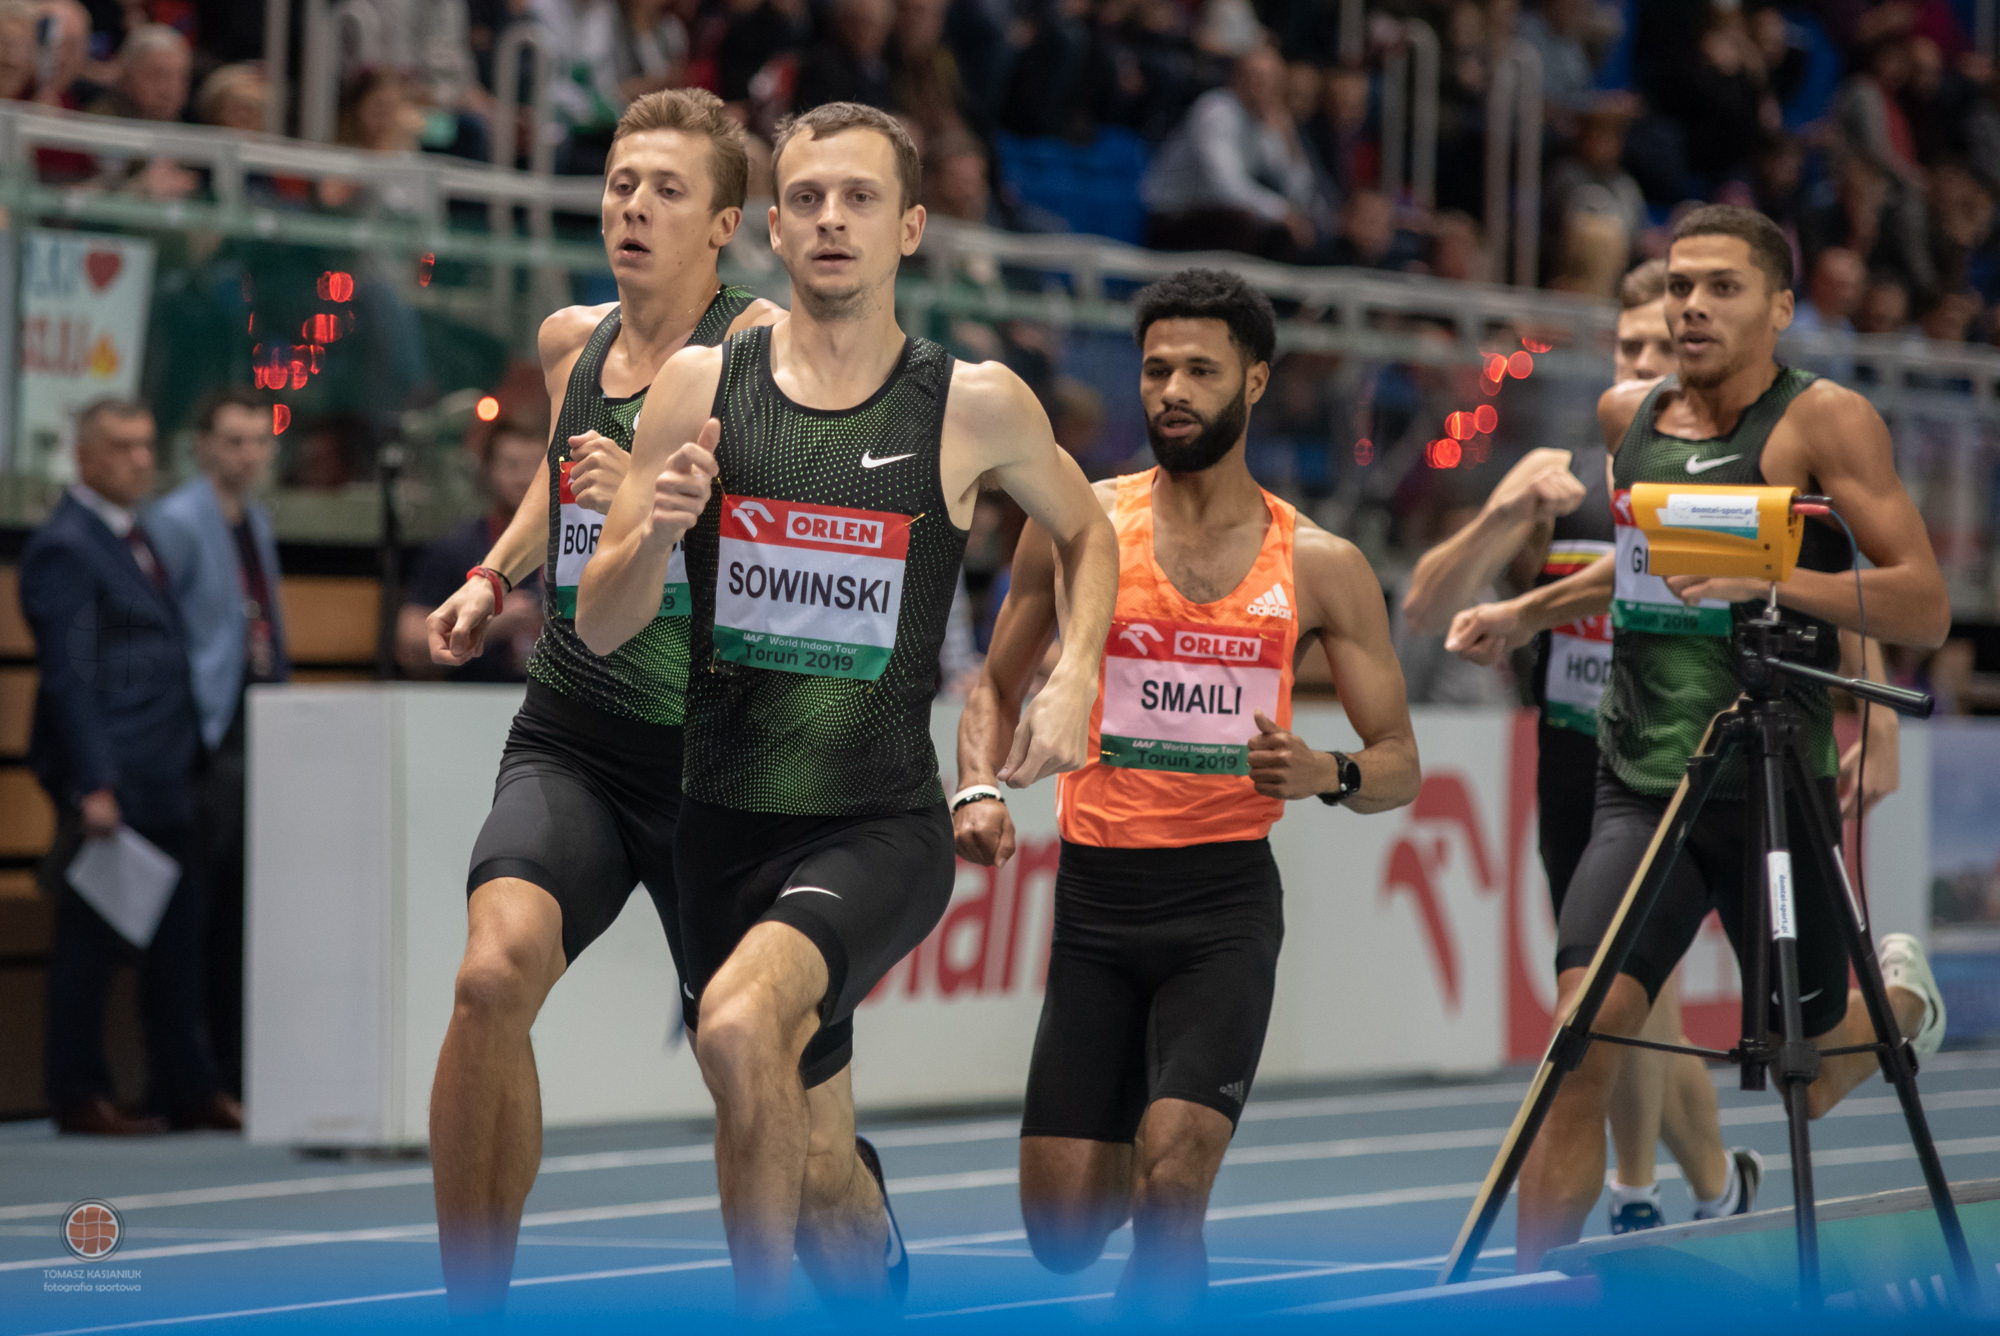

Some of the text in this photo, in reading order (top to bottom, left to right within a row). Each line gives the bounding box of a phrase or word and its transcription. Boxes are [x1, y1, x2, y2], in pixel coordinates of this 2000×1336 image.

[791, 516, 878, 544] ORLEN
[728, 561, 891, 614] SOWINSKI
[1246, 603, 1293, 621] adidas
[743, 632, 858, 655] IAAF World Indoor Tour
[1179, 635, 1256, 658] ORLEN
[745, 643, 854, 671] Toruń 2019
[1141, 679, 1242, 715] SMAILI
[1132, 740, 1241, 755] IAAF World Indoor Tour
[1138, 750, 1238, 770] Toruń 2019
